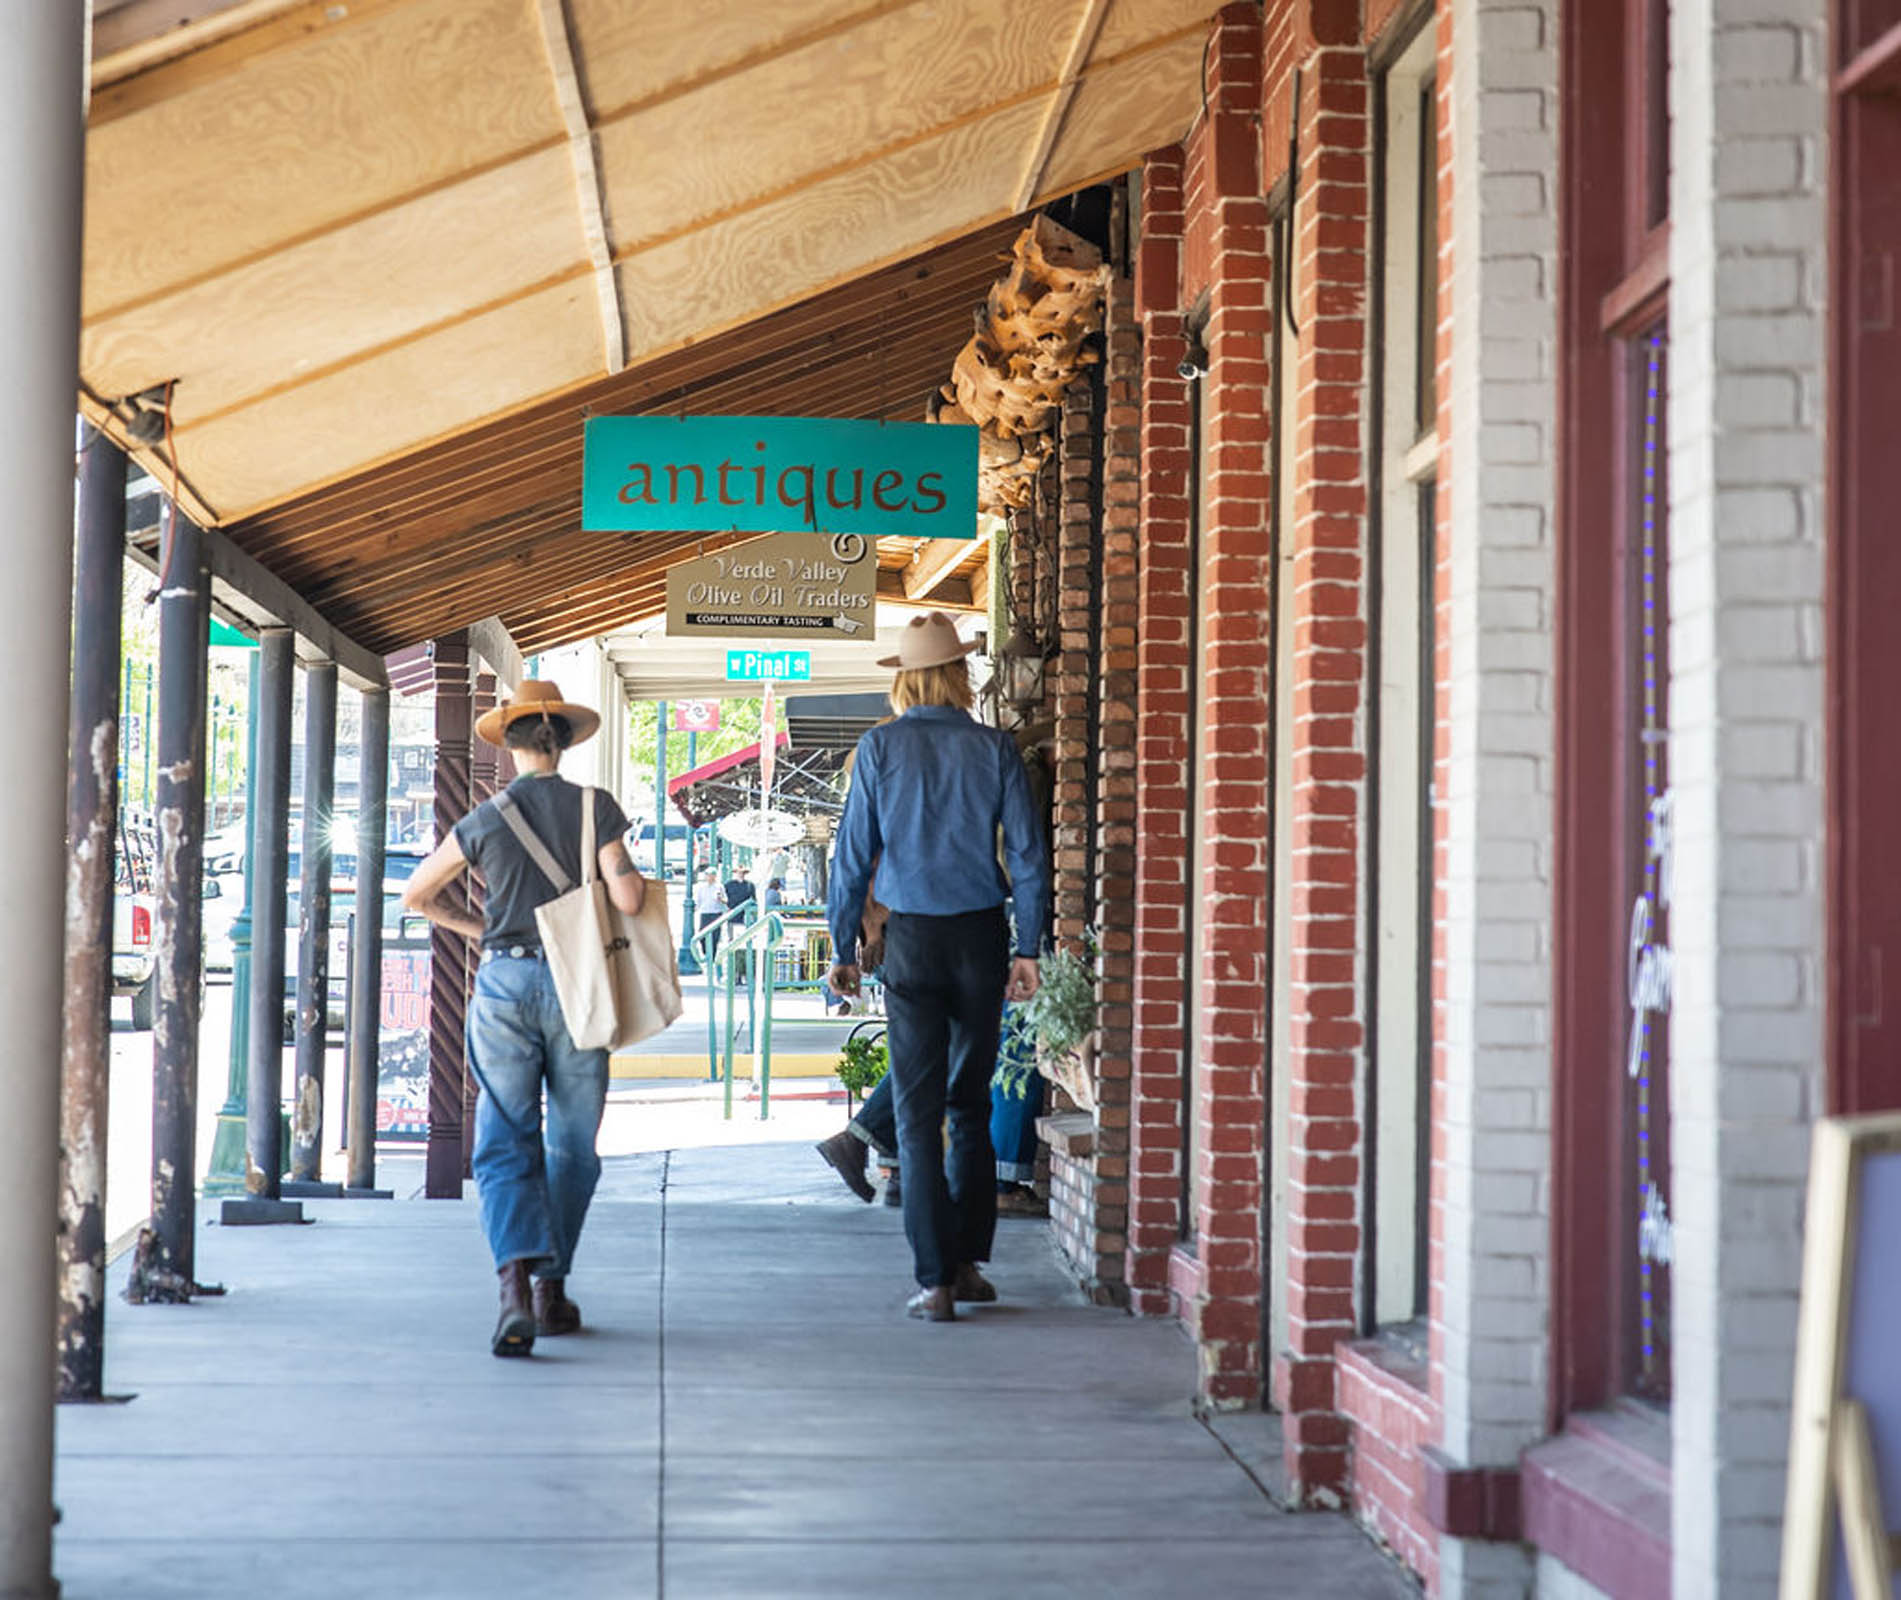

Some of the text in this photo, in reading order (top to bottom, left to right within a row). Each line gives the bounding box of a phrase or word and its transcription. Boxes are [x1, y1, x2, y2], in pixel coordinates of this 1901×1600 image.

[617, 440, 948, 525] antiques
[713, 556, 848, 584] Verde Valley
[687, 582, 870, 609] Olive Oil Traders
[696, 614, 823, 627] COMPLIMENTARY TASTING
[745, 653, 790, 677] Pinal
